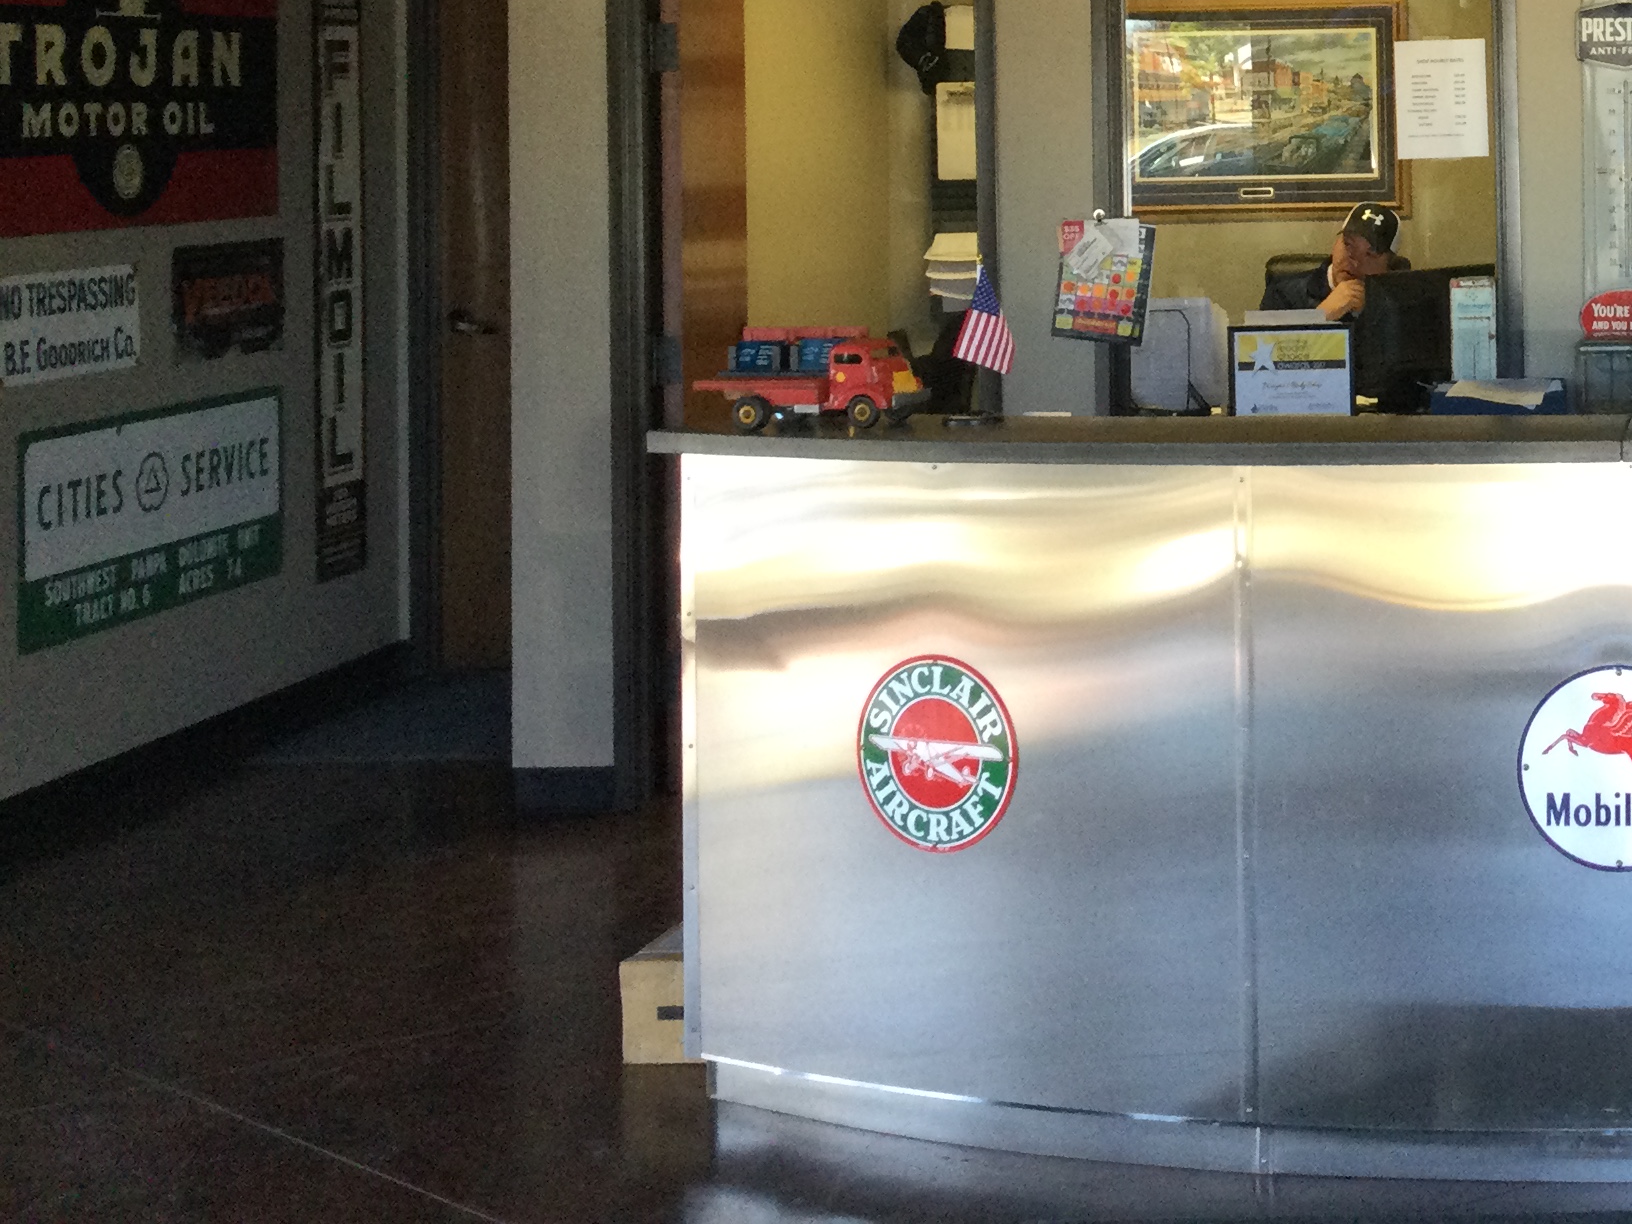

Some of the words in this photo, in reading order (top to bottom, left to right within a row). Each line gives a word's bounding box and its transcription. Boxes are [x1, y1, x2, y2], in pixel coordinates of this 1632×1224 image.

[0, 22, 242, 87] TROJAN
[21, 102, 148, 138] MOTOR
[163, 101, 215, 135] OIL
[25, 272, 136, 318] TRESPASSING
[37, 469, 124, 531] CITIES
[180, 437, 269, 497] SERVICE
[869, 666, 1003, 743] SINCLAIR
[866, 758, 1003, 842] AIRCRAFT
